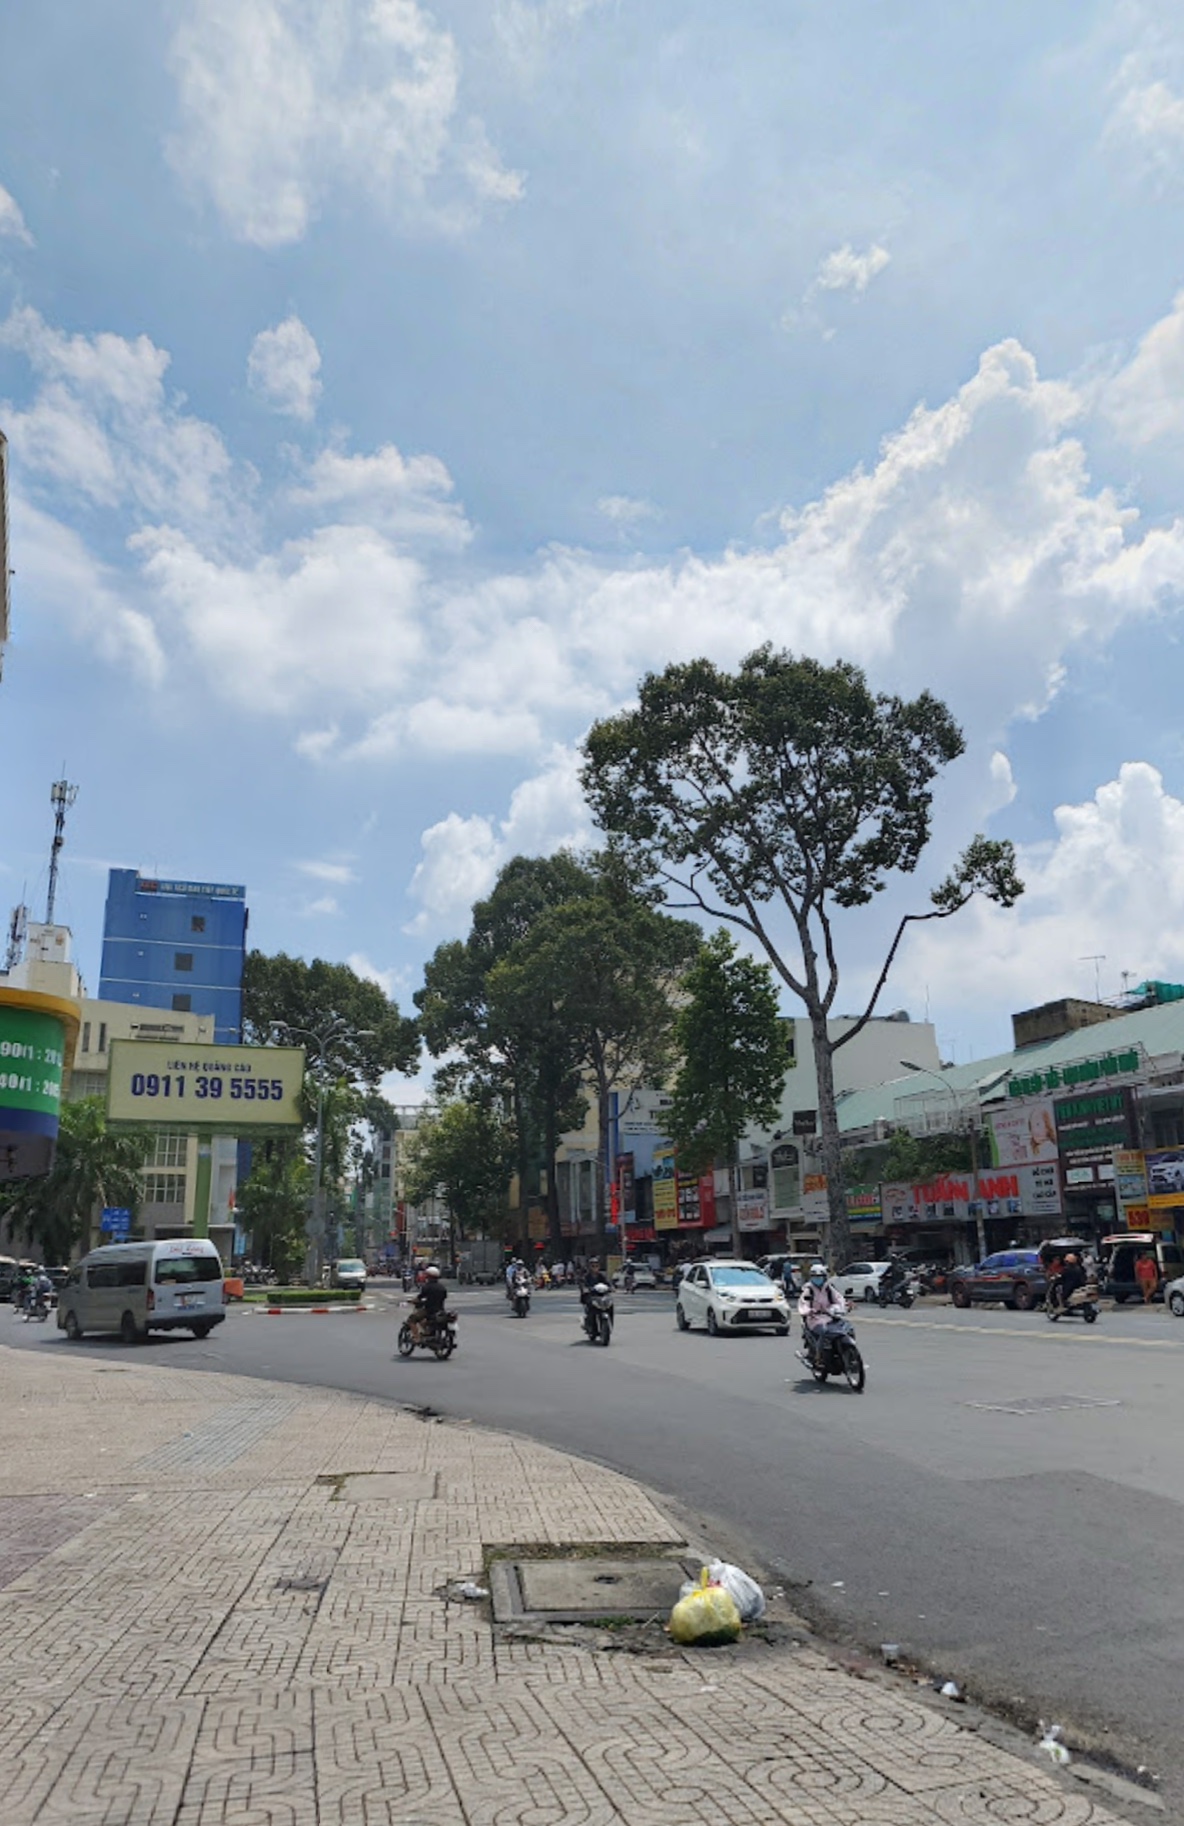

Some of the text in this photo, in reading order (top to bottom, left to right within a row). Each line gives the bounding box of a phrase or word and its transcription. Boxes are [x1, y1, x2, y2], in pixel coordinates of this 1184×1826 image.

[131, 1073, 283, 1101] 0911 39 5555
[912, 1173, 1019, 1204] TUẤN ANH
